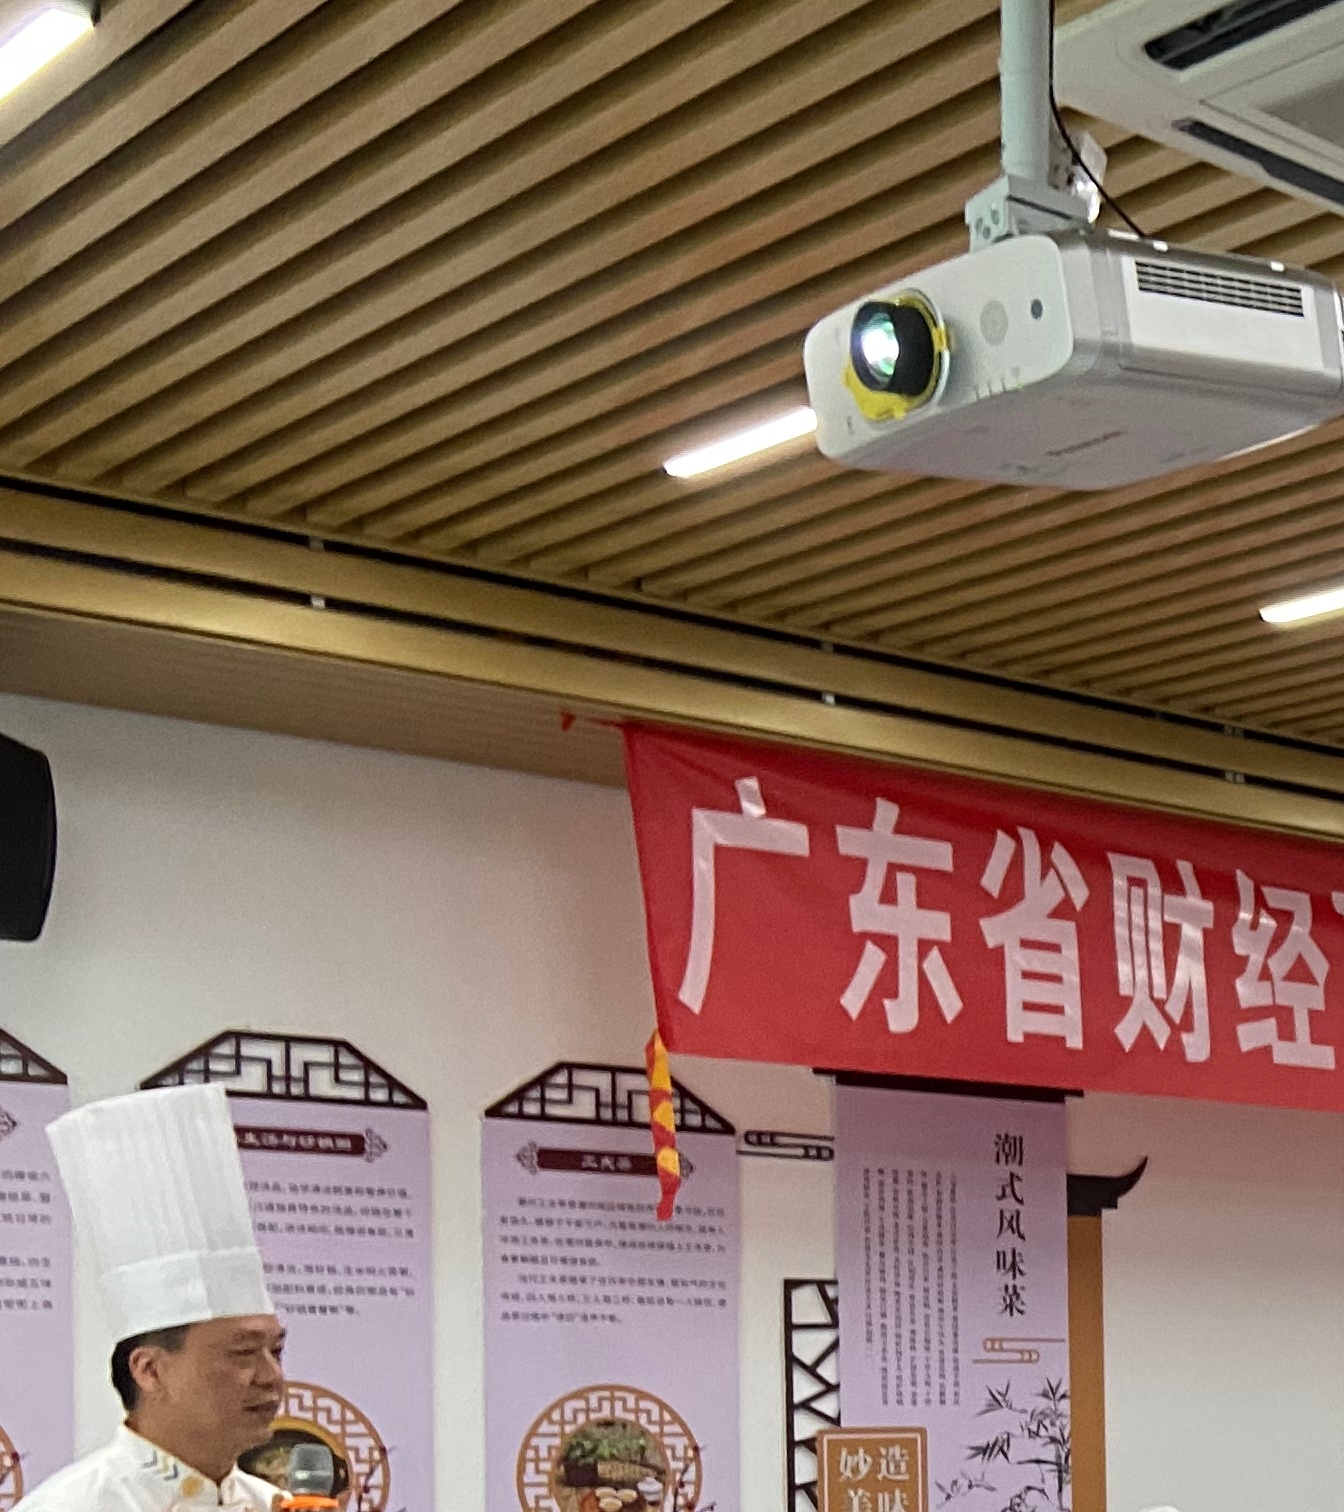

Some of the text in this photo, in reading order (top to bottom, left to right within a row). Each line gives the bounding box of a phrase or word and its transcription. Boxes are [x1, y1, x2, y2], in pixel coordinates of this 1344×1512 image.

[993, 1133, 1026, 1317] 潮式风味菜
[838, 1445, 910, 1482] 妙造
